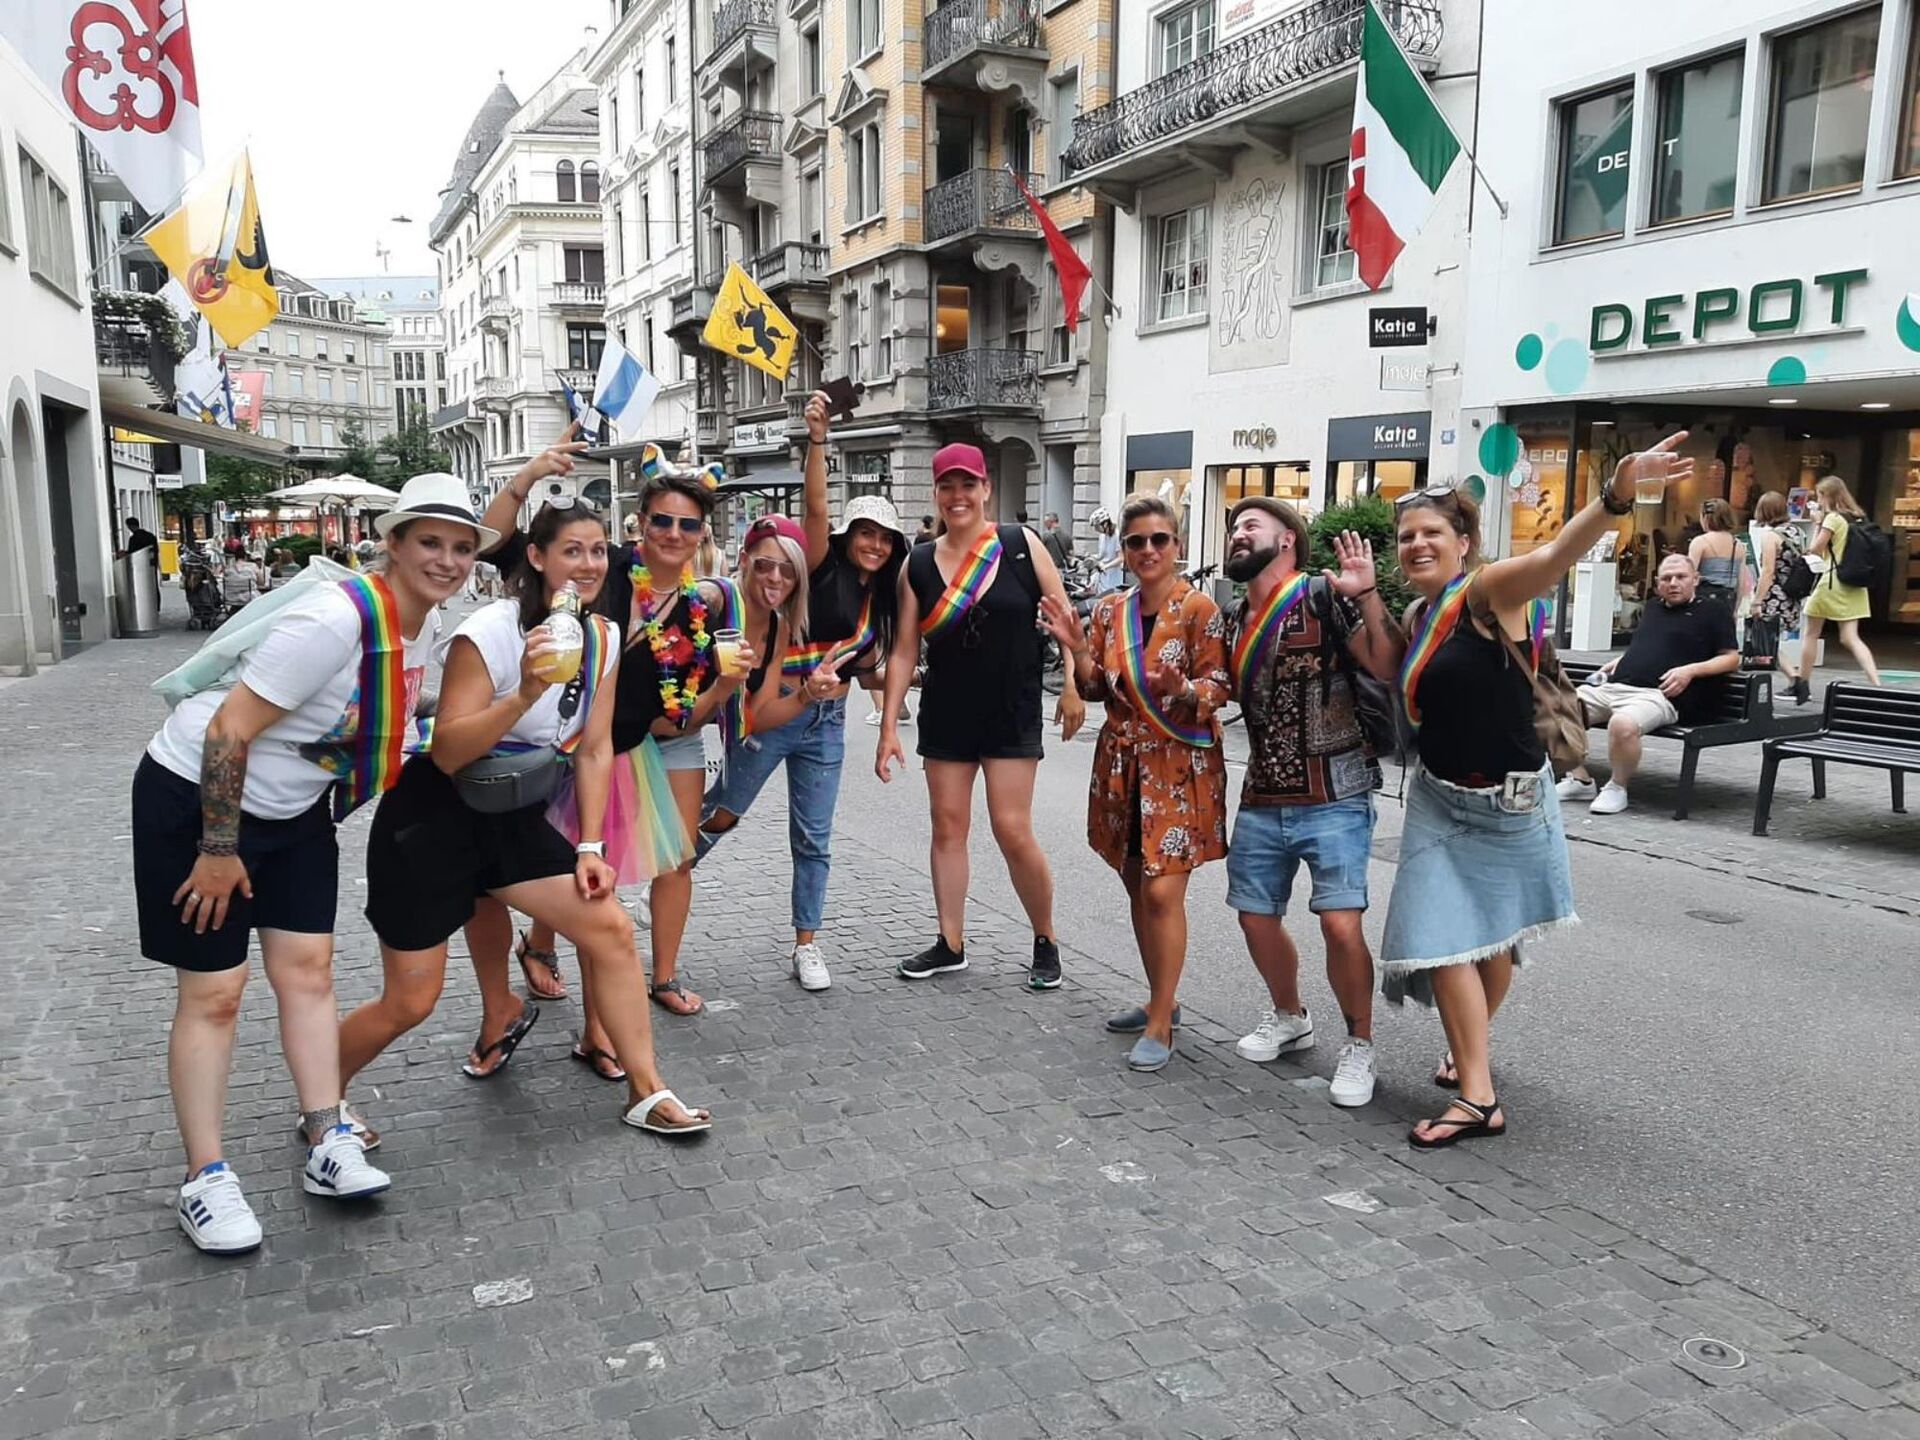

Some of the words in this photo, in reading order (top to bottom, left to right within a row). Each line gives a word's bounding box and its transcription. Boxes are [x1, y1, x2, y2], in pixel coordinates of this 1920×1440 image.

[1589, 268, 1868, 350] DEPOT
[1374, 316, 1417, 338] Katja
[1232, 422, 1277, 453] maje
[1374, 421, 1417, 448] Katja
